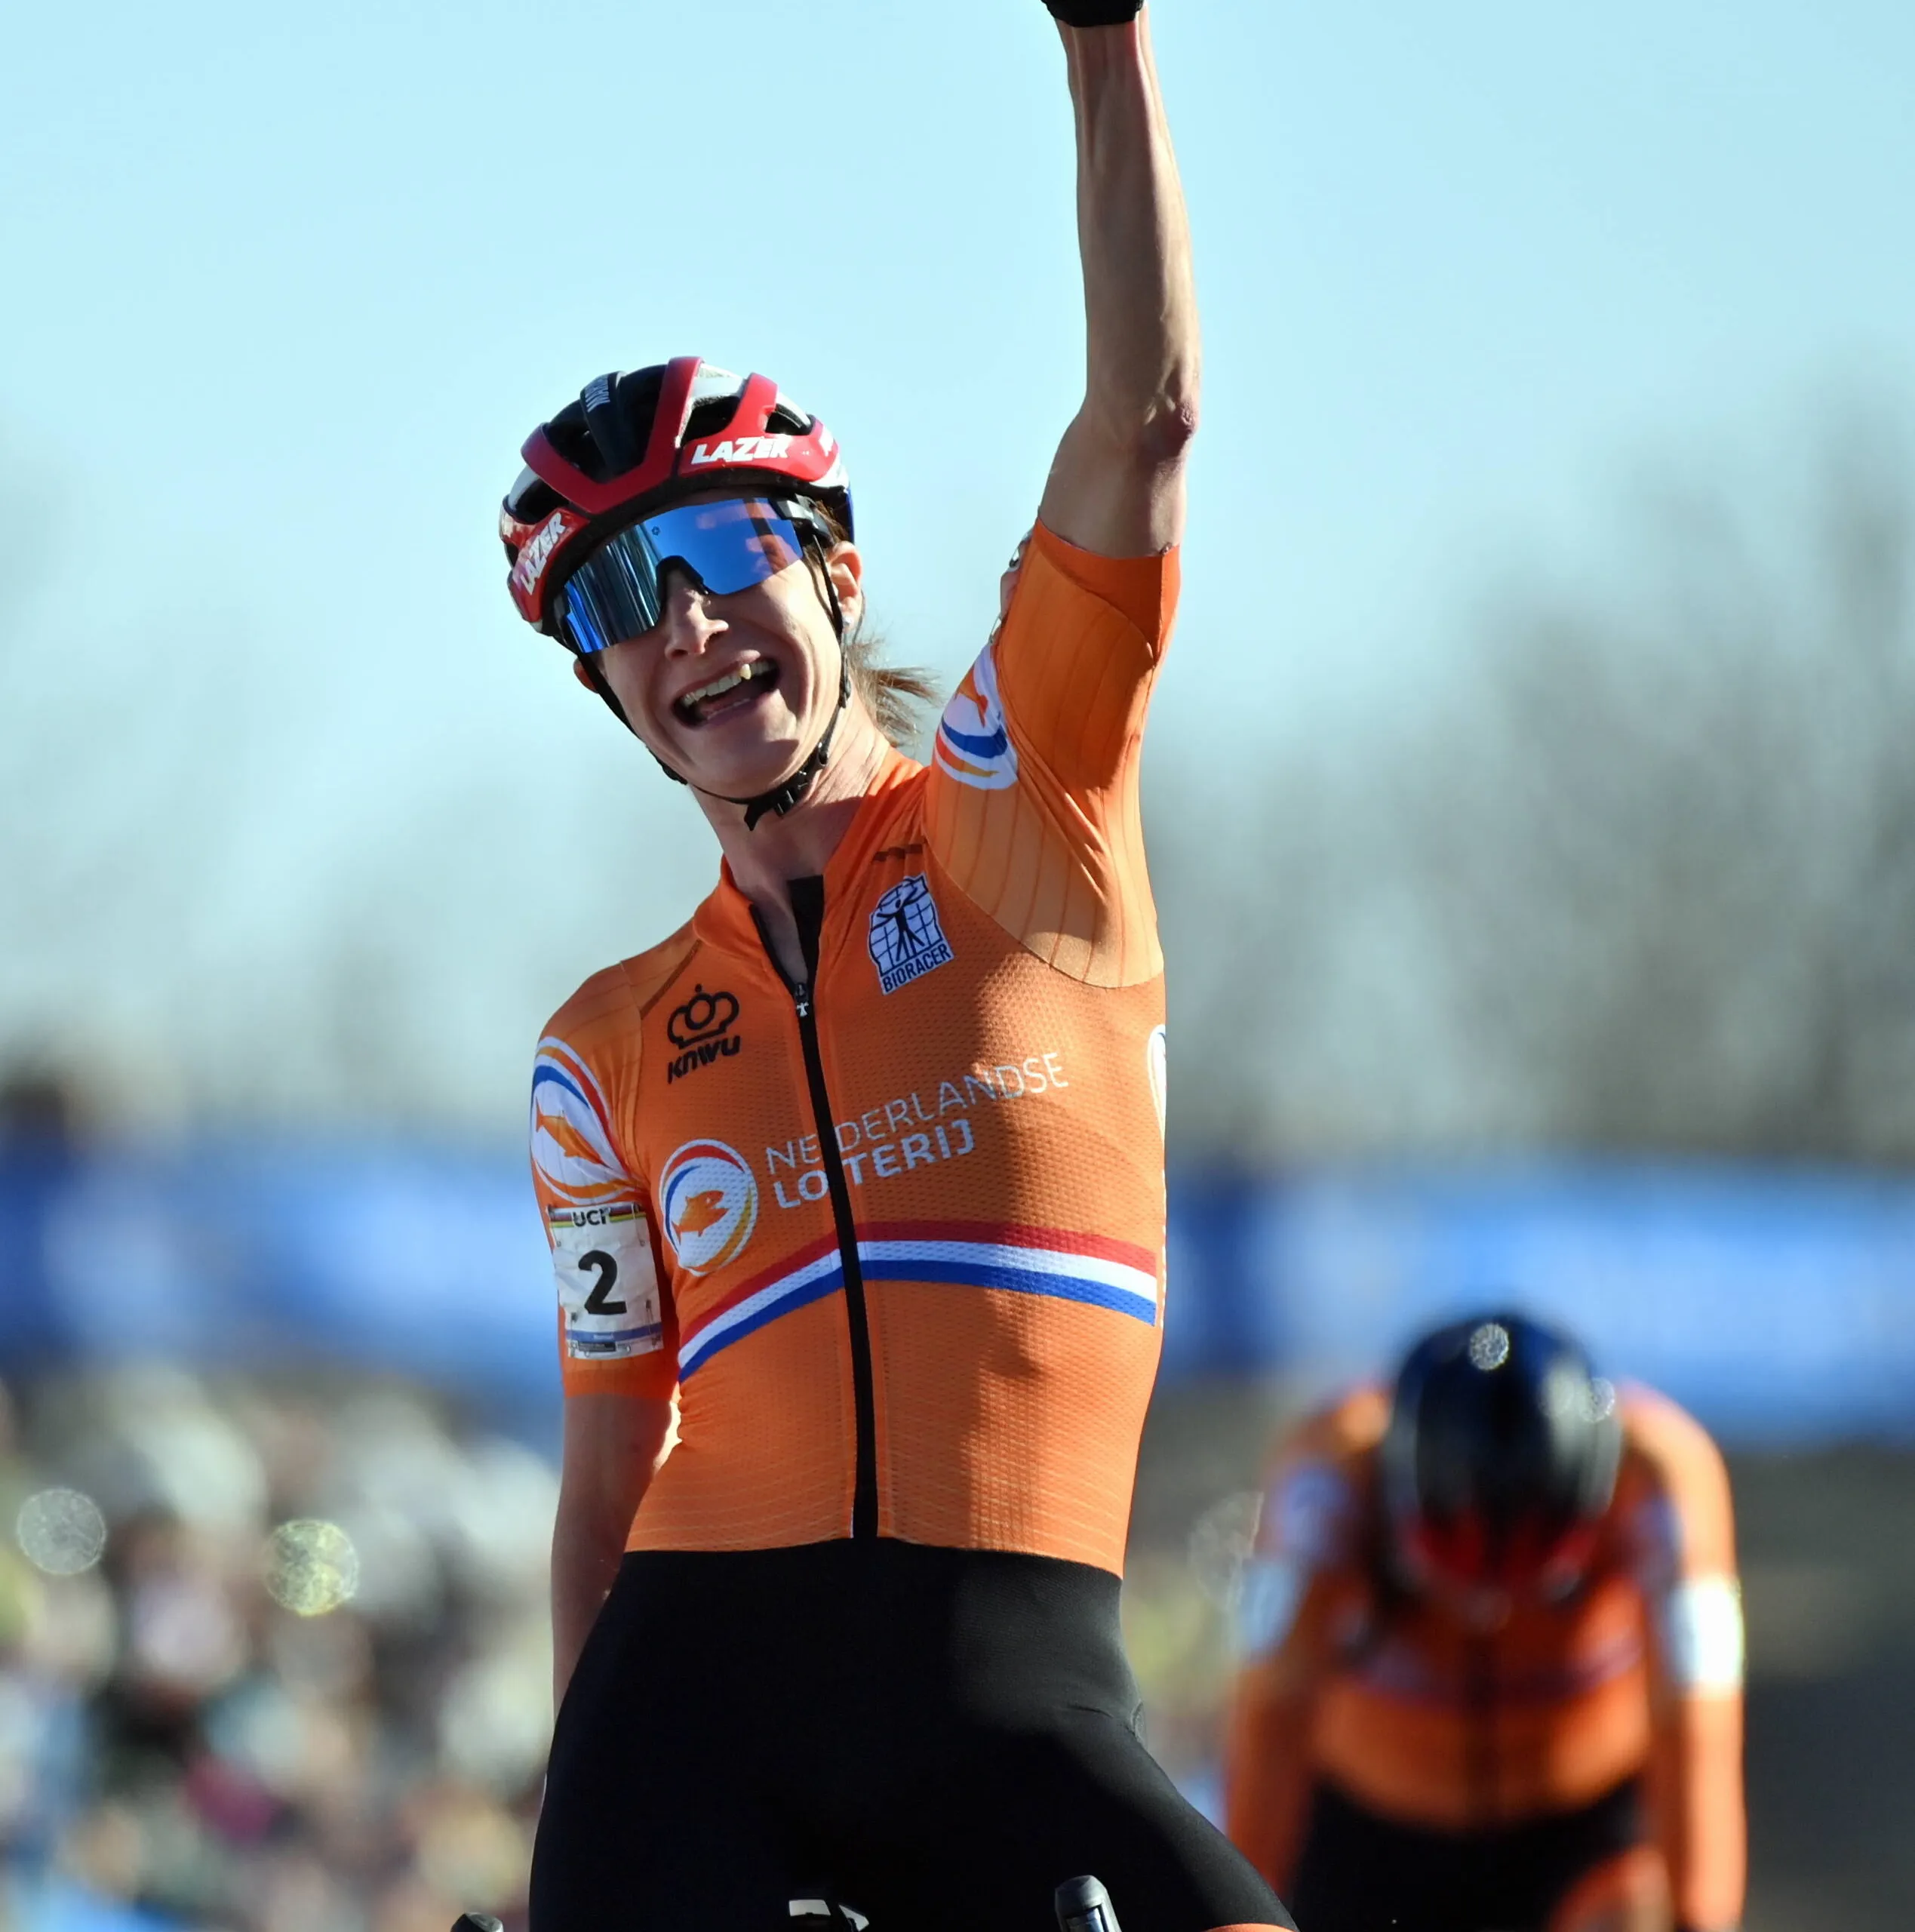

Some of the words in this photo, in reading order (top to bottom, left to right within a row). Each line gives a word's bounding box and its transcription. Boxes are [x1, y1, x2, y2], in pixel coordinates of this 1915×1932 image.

[690, 435, 789, 464] LAZER
[520, 512, 567, 595] LAZER
[882, 943, 951, 993] BIORACER
[766, 1052, 1069, 1174] NEDERLANDSE
[773, 1118, 976, 1208] LOTERIJ
[571, 1208, 610, 1227] UCI
[578, 1250, 628, 1315] 2
